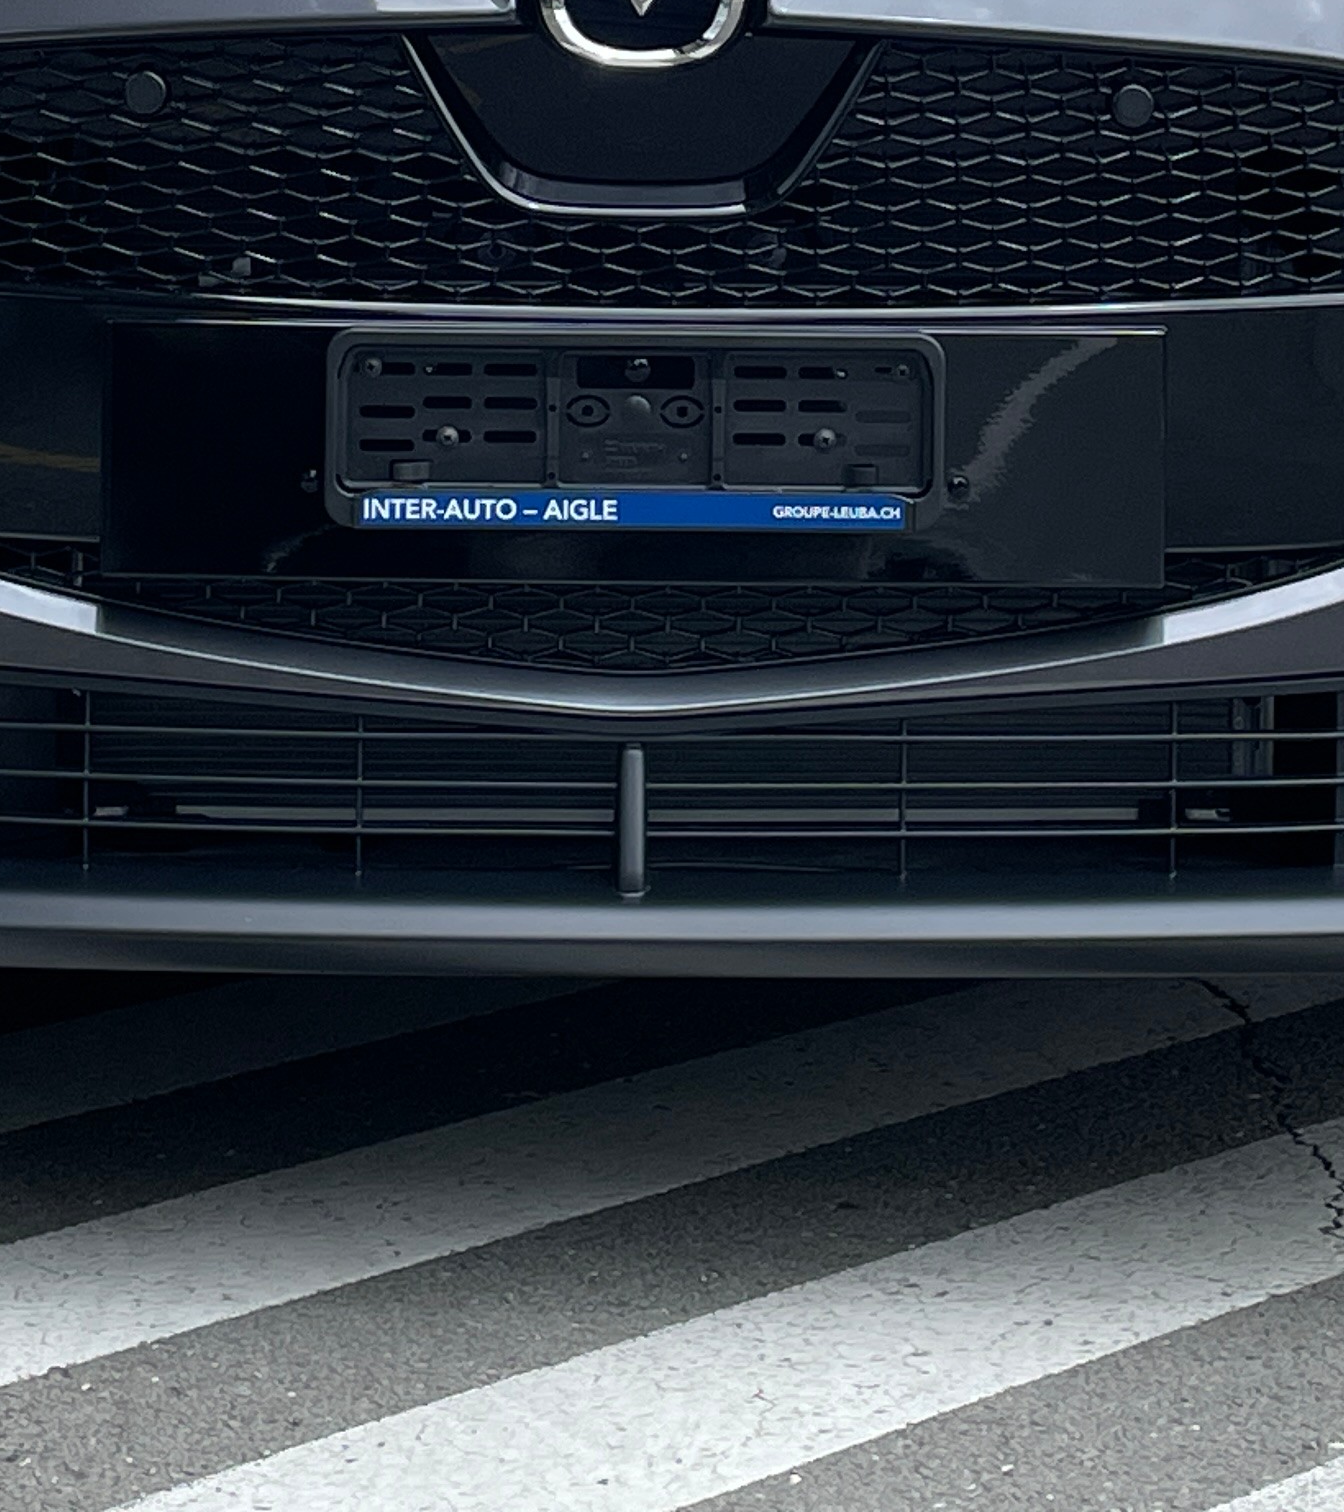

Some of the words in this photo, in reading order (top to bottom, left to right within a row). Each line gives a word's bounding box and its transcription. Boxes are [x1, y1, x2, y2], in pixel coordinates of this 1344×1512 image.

[362, 498, 518, 521] INTER-AUTO
[542, 499, 619, 522] AIGLE
[772, 504, 902, 520] GROUPE-LEUBA.CH
